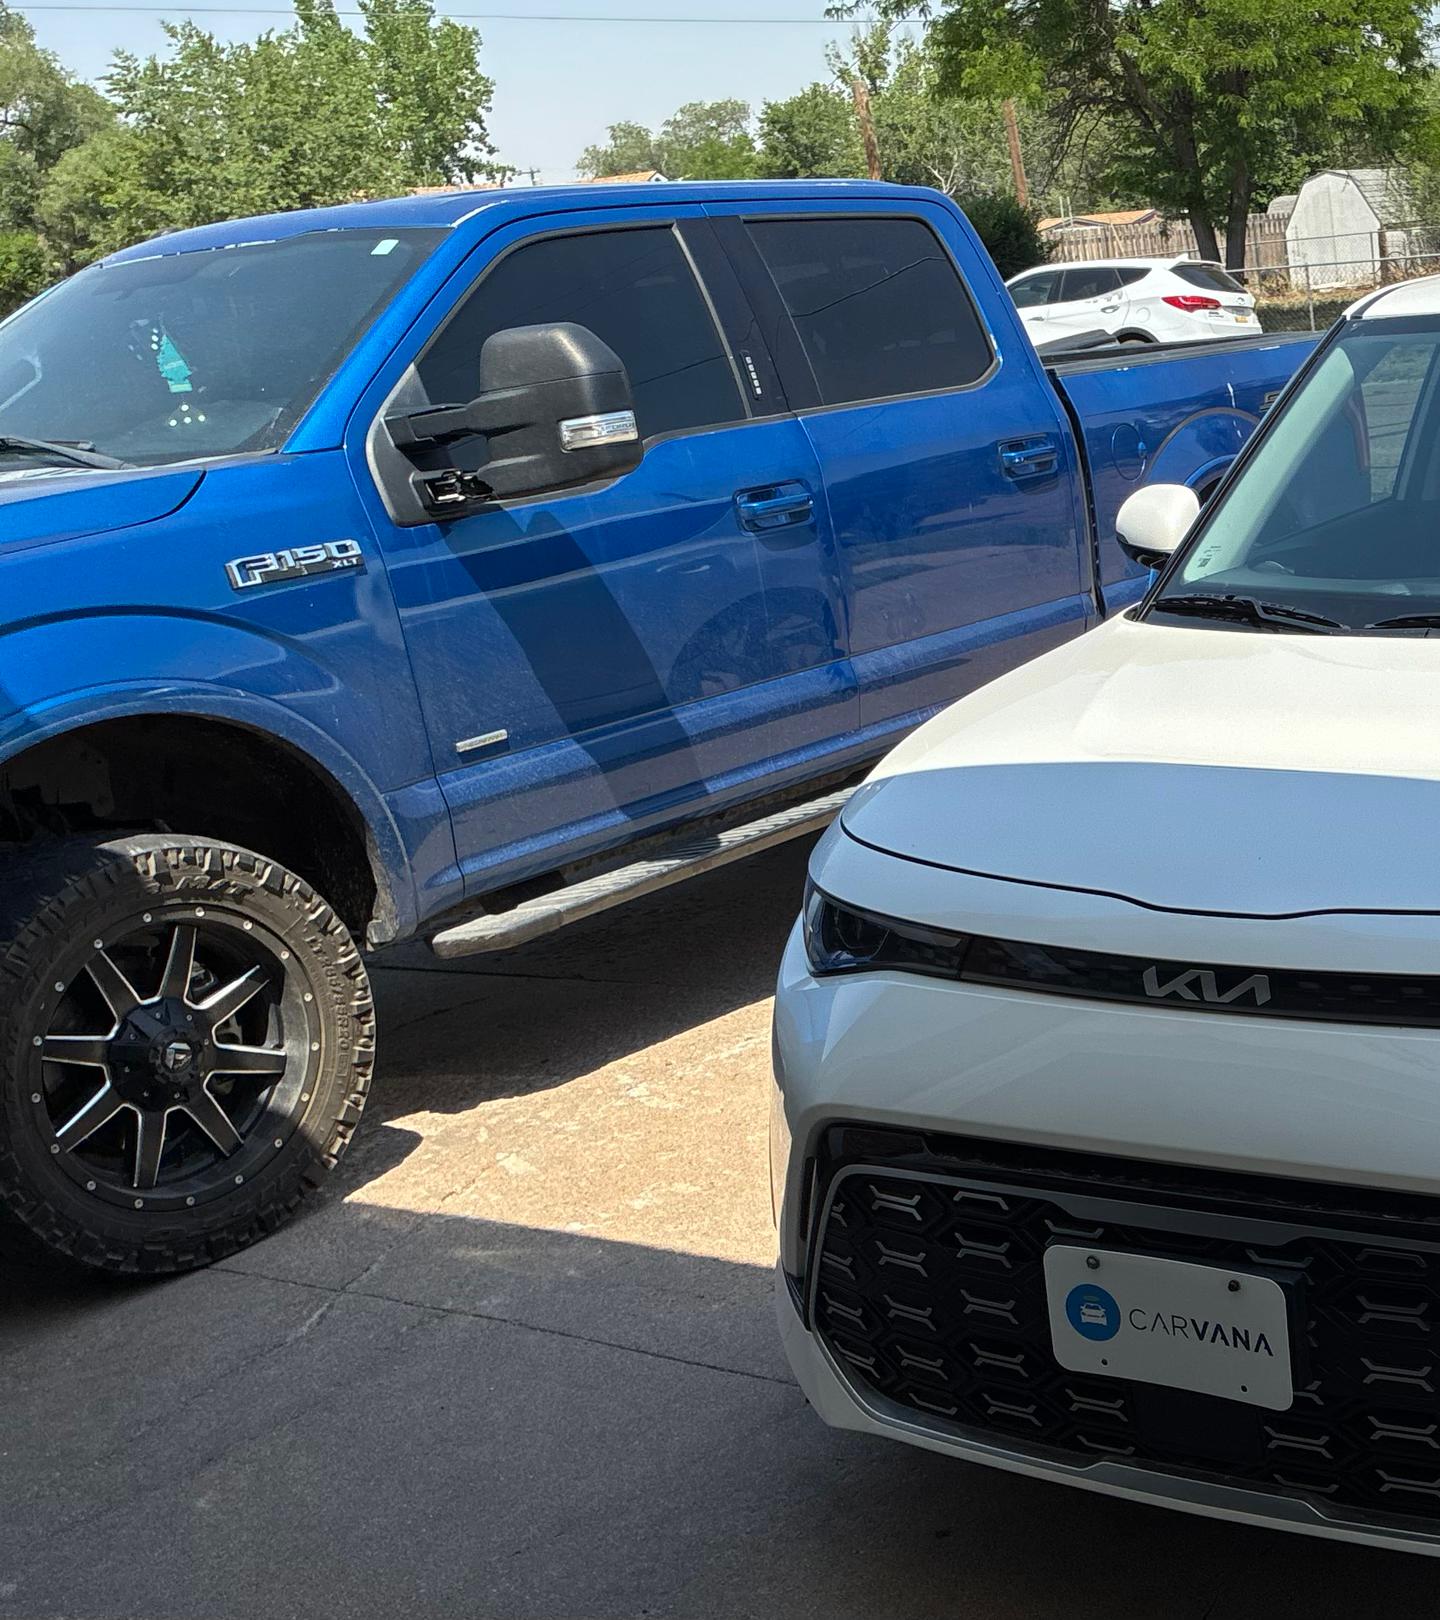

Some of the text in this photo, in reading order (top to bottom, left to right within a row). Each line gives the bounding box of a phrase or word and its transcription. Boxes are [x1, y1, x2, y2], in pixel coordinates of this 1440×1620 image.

[332, 557, 360, 569] XLT
[1142, 965, 1272, 1006] KIA
[1129, 1308, 1274, 1357] CARVANA
